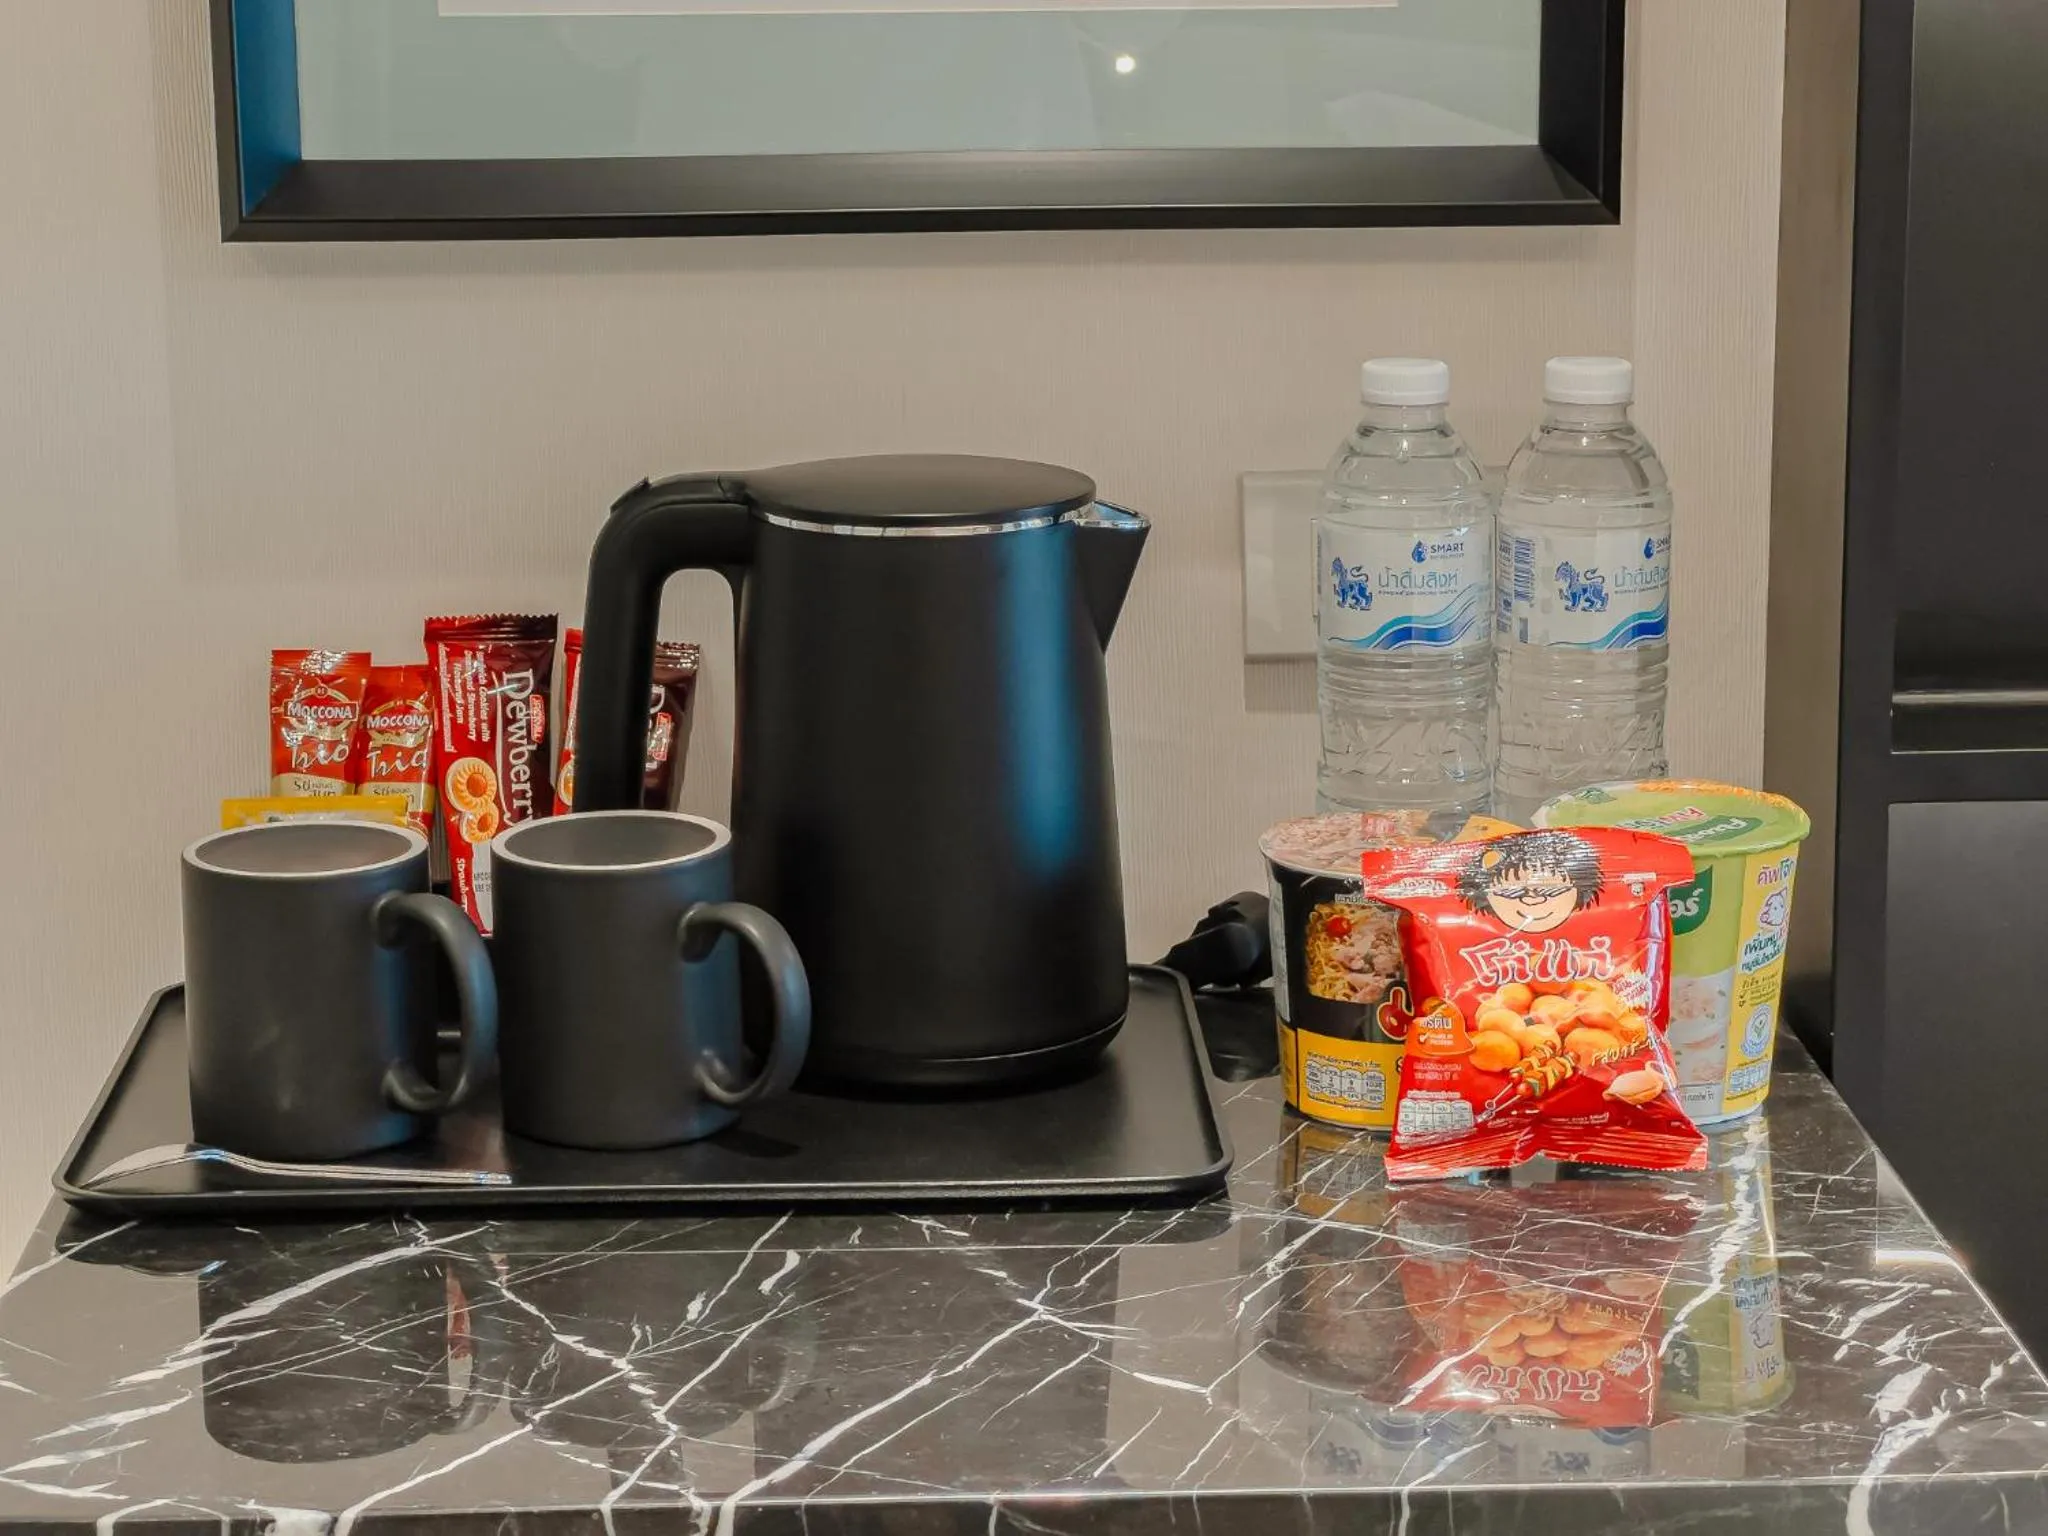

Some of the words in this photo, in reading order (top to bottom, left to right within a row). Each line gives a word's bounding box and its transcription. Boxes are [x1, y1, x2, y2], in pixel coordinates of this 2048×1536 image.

[1430, 542, 1464, 554] SMART
[287, 702, 352, 719] MOCCONA
[479, 686, 490, 721] Cookies
[366, 714, 430, 729] MOCCONA
[456, 705, 465, 724] Jam
[466, 693, 477, 742] Strawberry
[481, 723, 491, 742] with
[1668, 888, 1704, 918] อร์
